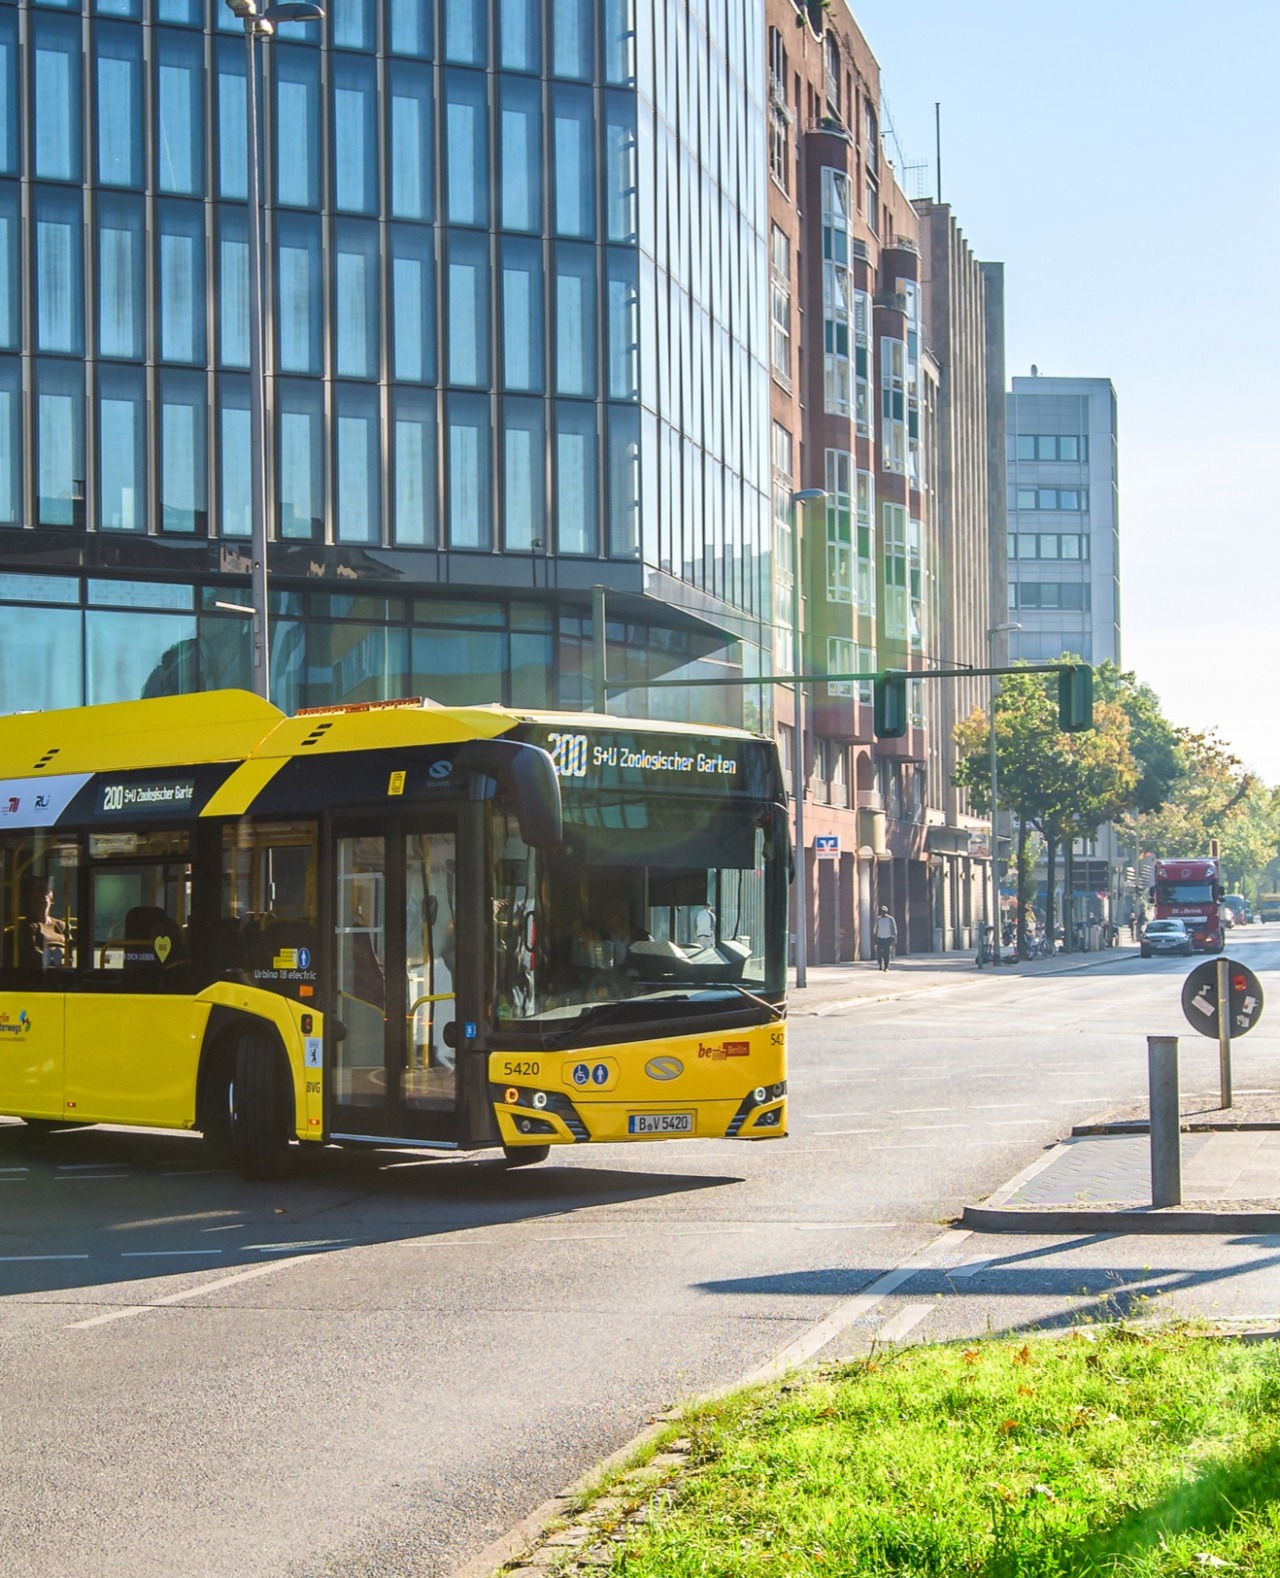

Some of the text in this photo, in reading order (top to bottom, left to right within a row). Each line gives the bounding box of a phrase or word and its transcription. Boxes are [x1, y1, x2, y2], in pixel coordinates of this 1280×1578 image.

[548, 733, 736, 777] 200 S+U Zoologischer Garten
[104, 785, 124, 810] 200
[254, 969, 278, 979] Urbino
[288, 970, 317, 980] electric
[503, 1062, 540, 1076] 5420
[306, 1081, 321, 1094] BVG
[662, 1116, 689, 1130] 5420
